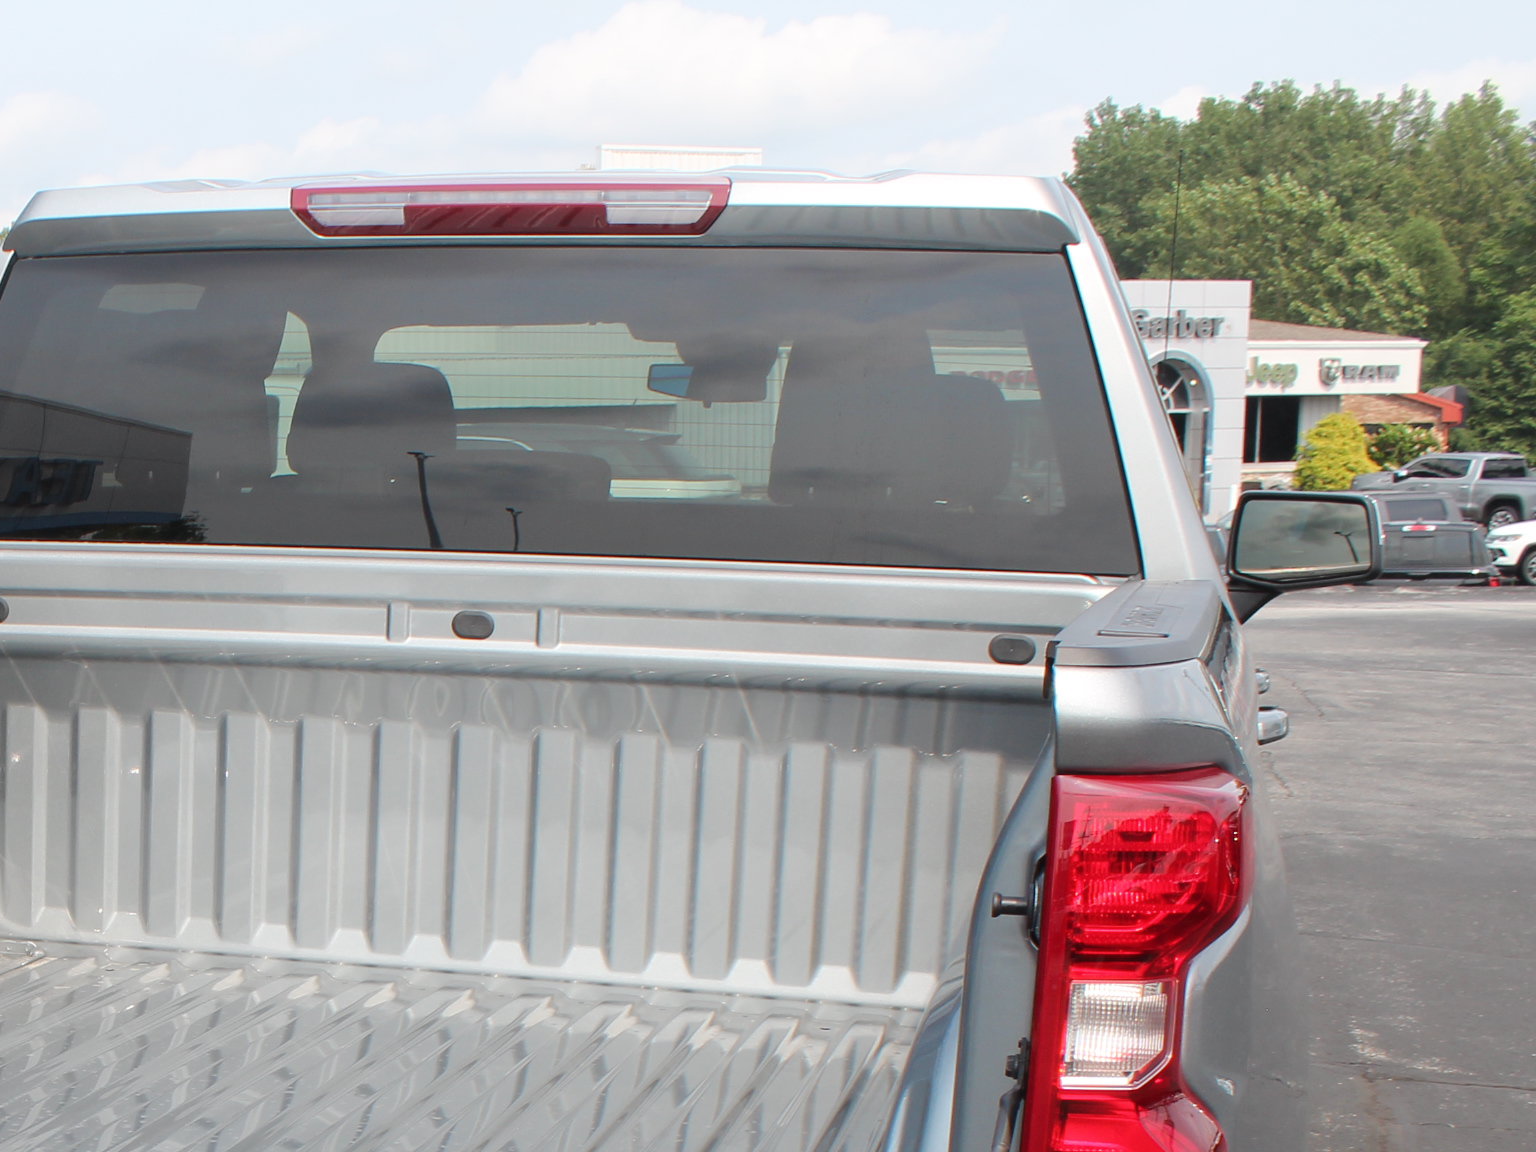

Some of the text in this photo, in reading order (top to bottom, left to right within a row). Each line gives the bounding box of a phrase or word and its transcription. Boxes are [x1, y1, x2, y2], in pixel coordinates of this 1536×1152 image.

[1131, 309, 1225, 338] Garber
[1246, 355, 1298, 389] Jeep
[1341, 364, 1400, 381] RAM
